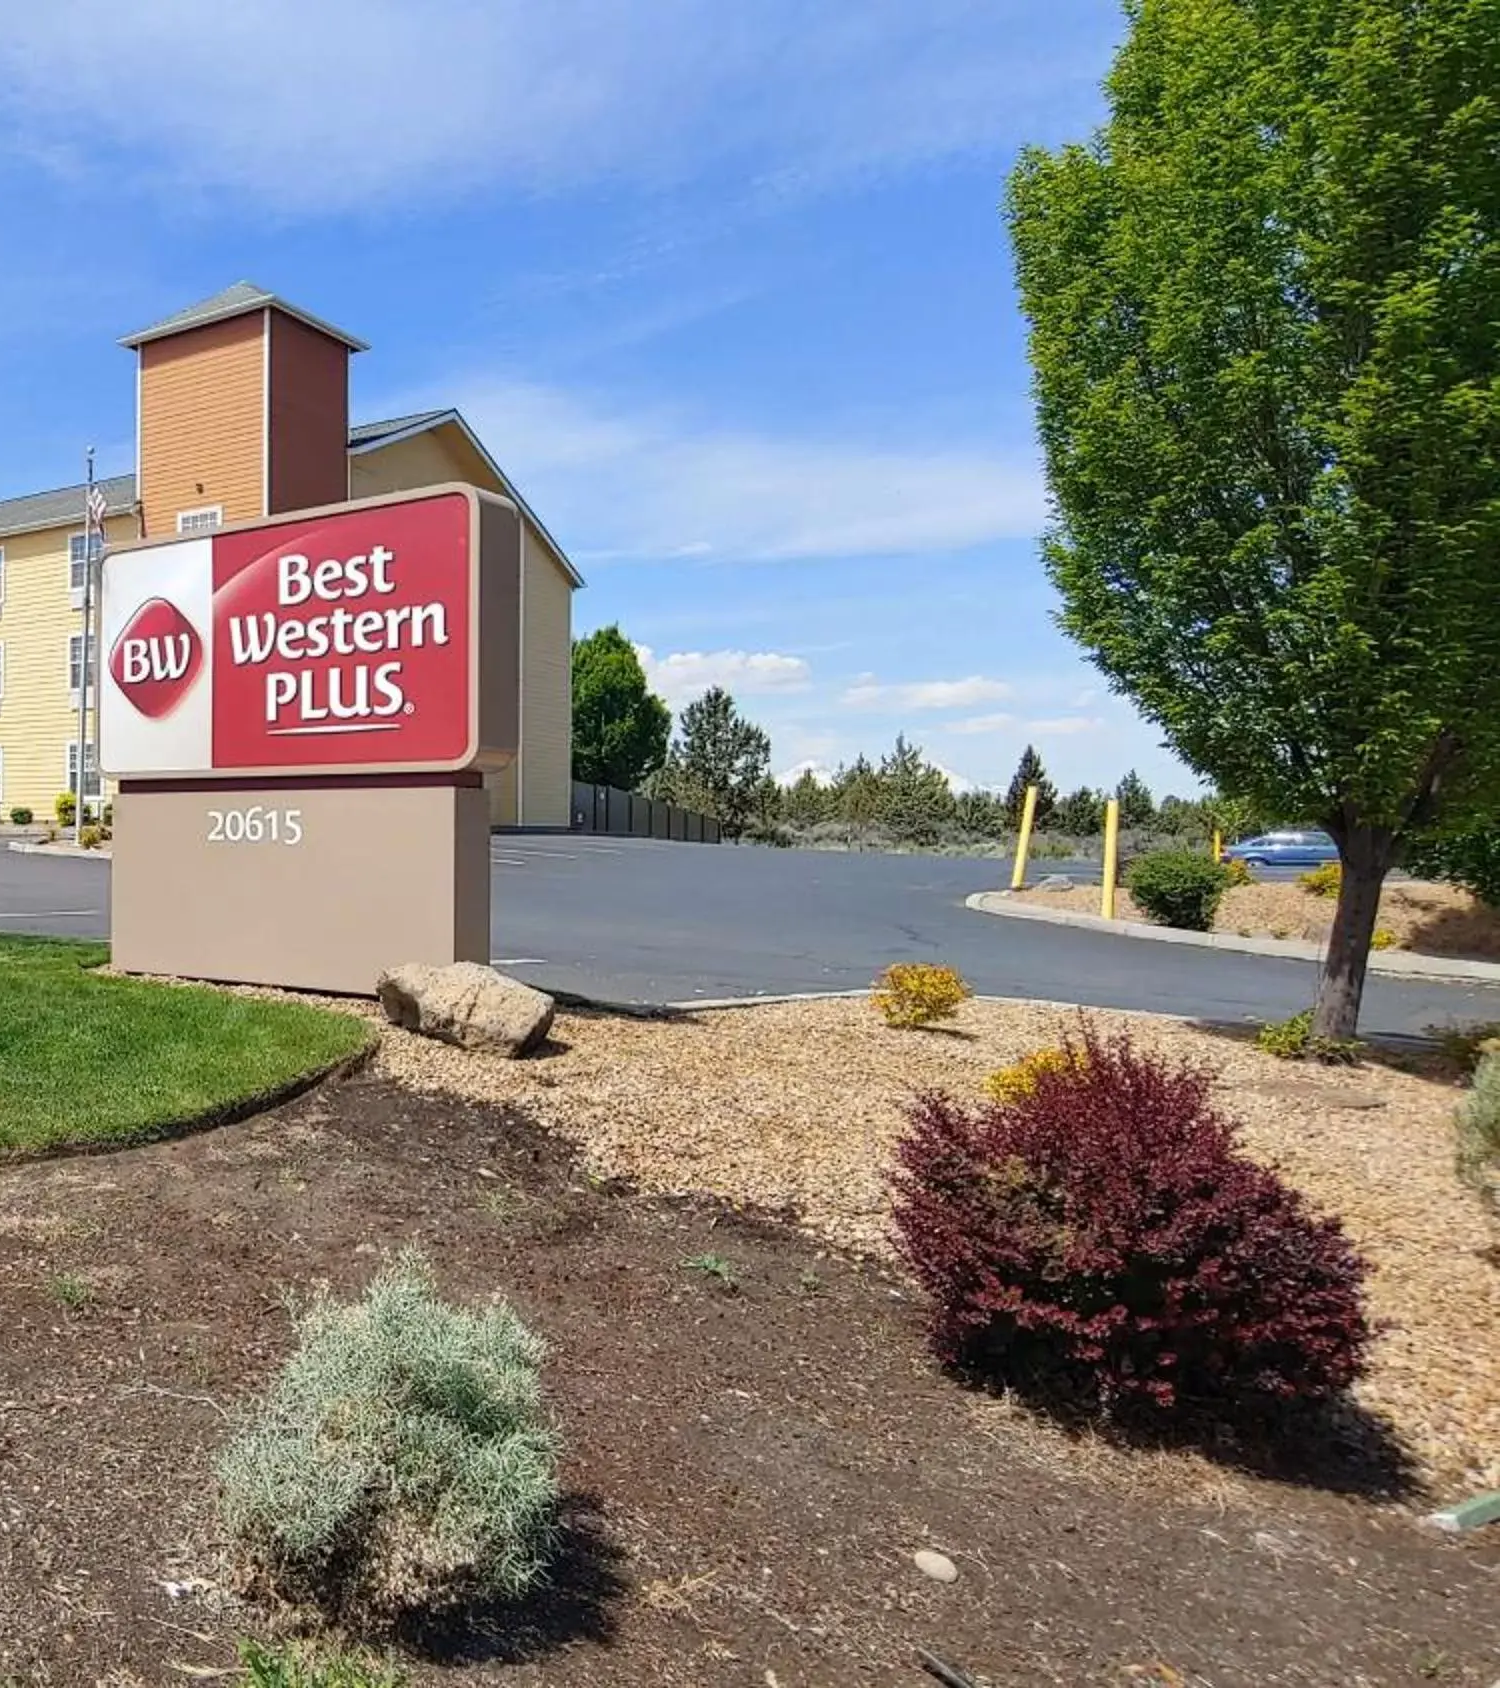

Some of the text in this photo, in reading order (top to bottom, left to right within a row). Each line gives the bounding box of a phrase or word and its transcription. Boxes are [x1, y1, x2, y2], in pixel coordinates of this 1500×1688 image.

[277, 545, 396, 606] Best
[122, 633, 191, 684] BW
[228, 601, 449, 665] Western
[207, 806, 302, 844] 20615
